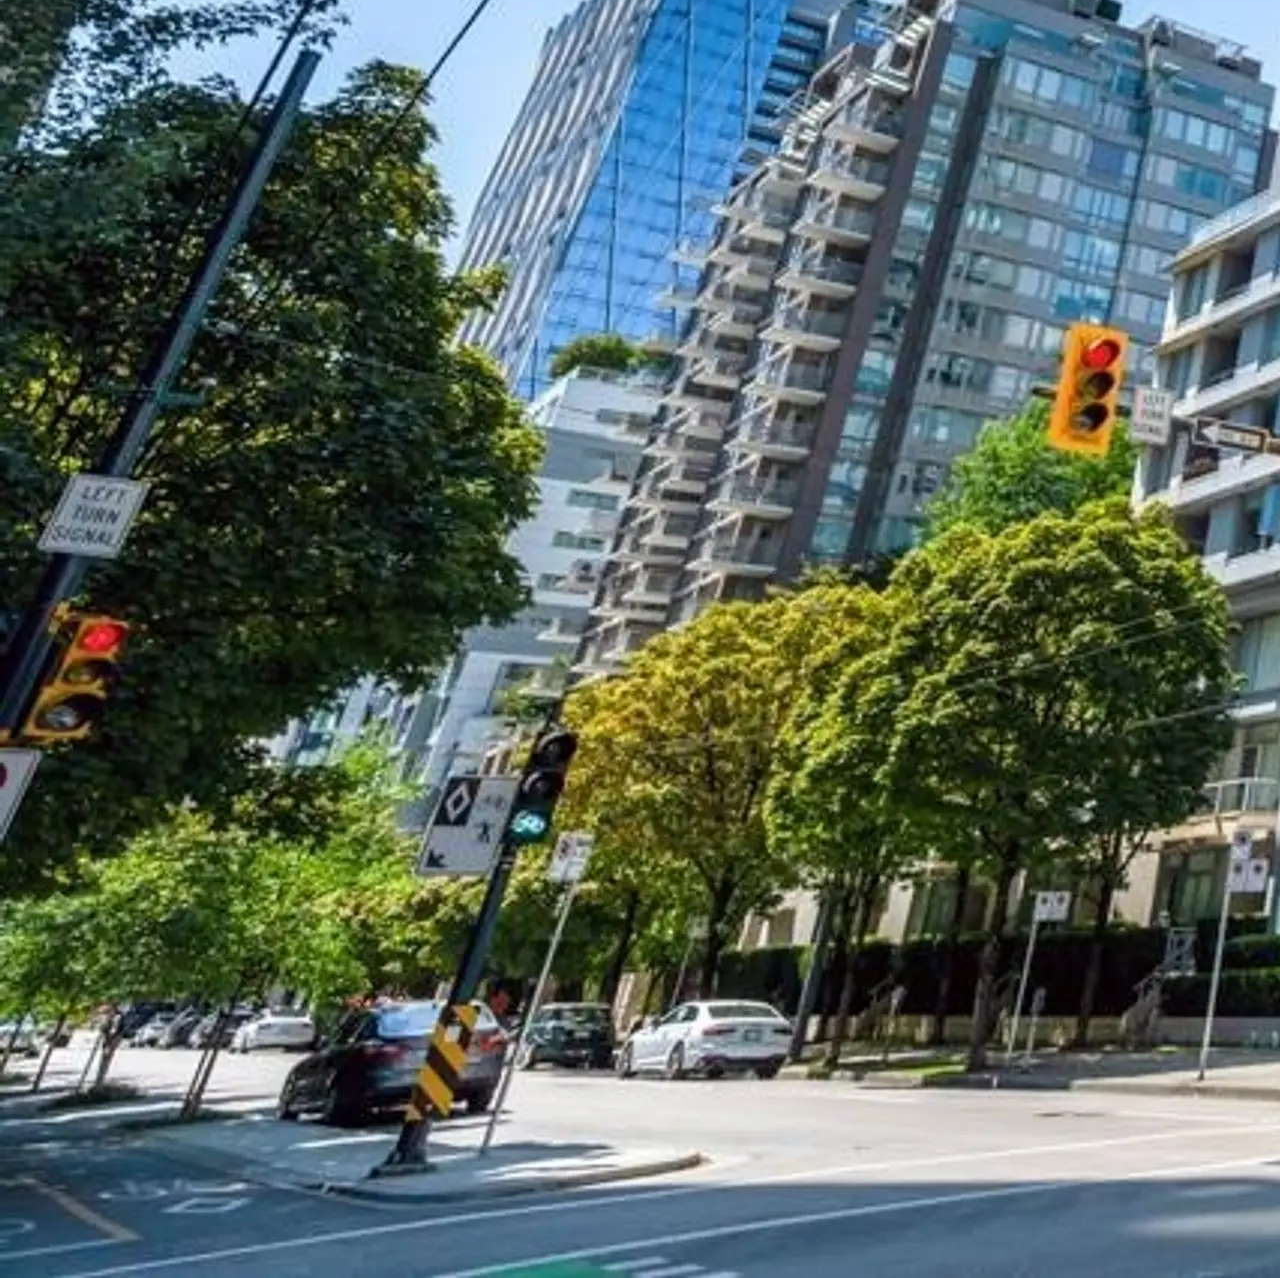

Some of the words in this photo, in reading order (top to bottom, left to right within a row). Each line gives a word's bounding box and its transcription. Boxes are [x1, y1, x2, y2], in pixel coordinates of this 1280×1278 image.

[81, 485, 126, 503] LEFT
[71, 504, 121, 525] TURN
[50, 524, 116, 547] SIGNAL
